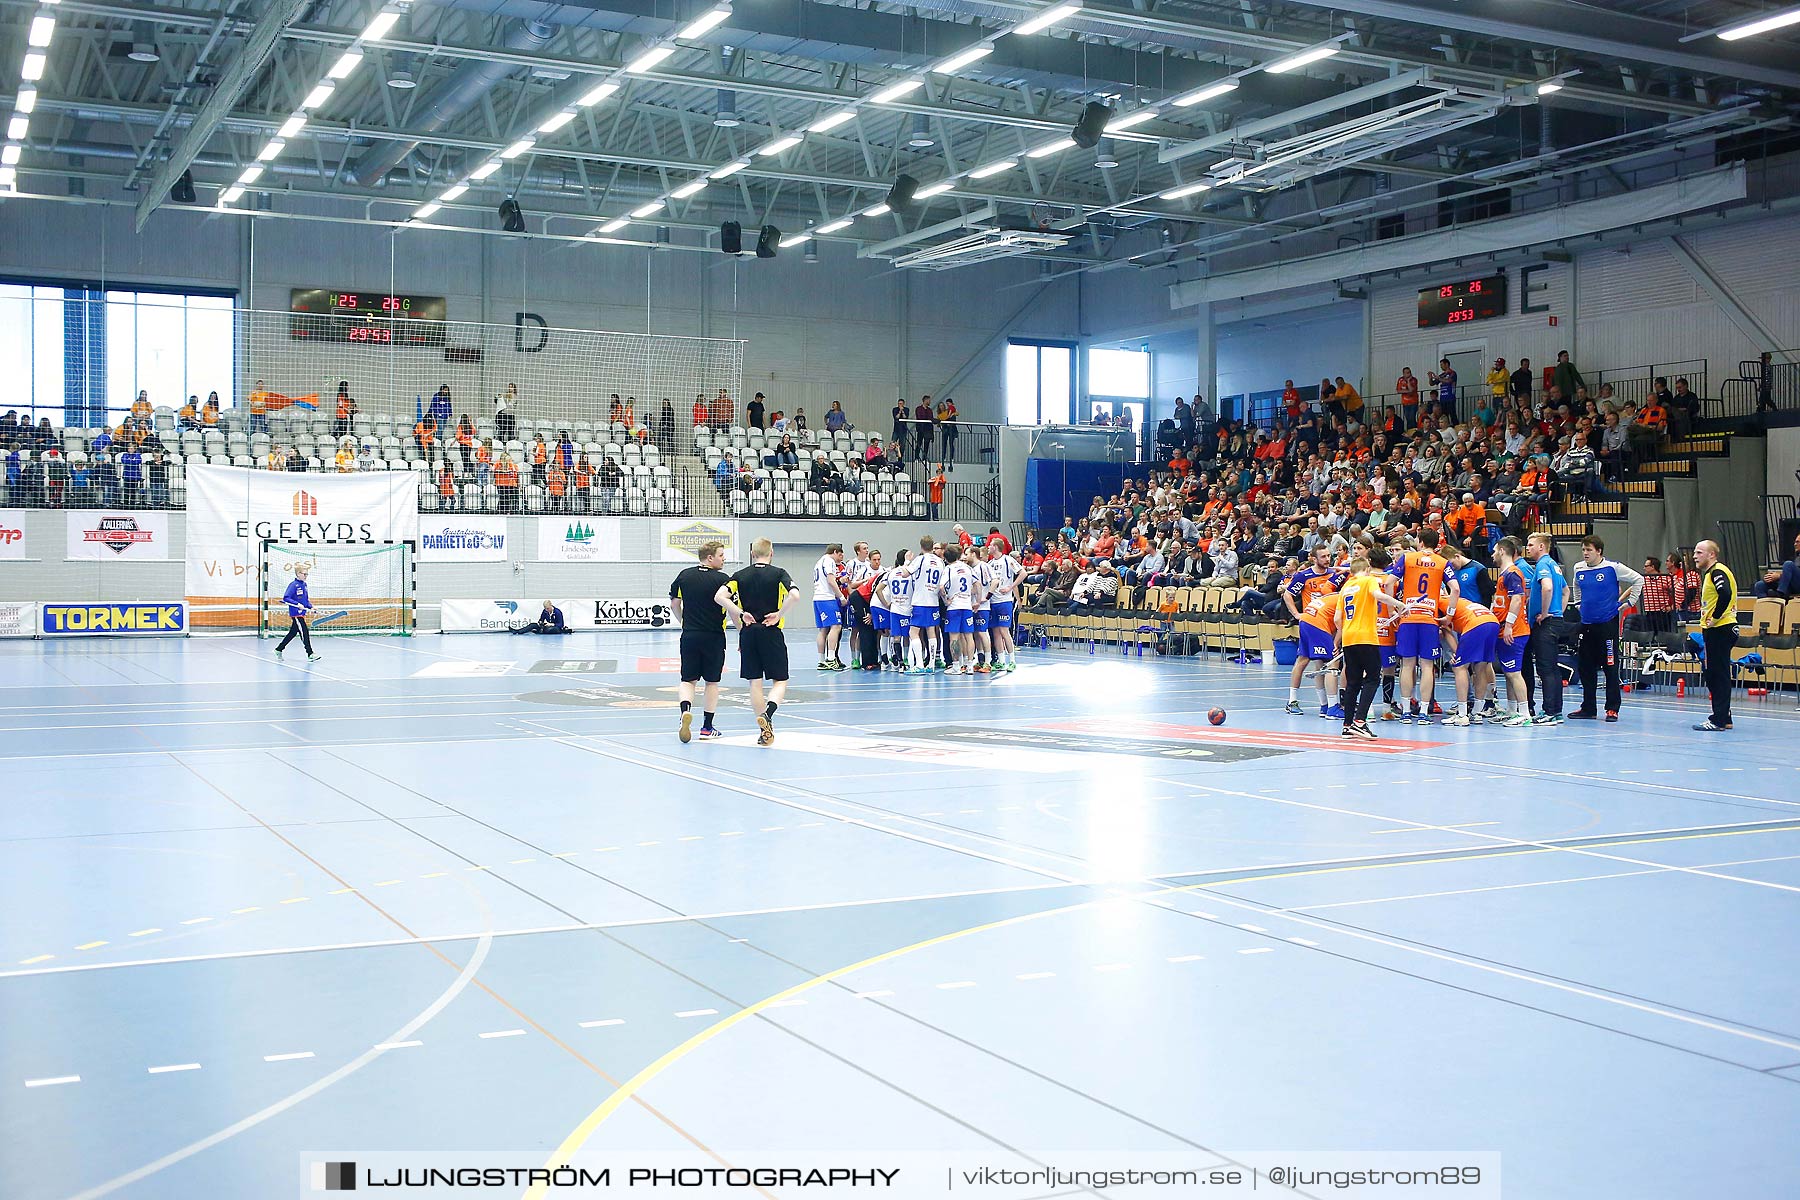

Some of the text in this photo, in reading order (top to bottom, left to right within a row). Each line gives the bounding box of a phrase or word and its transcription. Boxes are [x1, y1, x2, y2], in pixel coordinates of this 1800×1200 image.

[1440, 281, 1481, 298] 25 26
[1521, 263, 1549, 314] E
[329, 294, 411, 310] H 25 26 G
[1458, 298, 1463, 307] 2
[366, 312, 374, 323] 2
[515, 312, 549, 353] D
[236, 520, 371, 541] EGERYDS
[204, 560, 223, 577] Vi
[925, 568, 940, 585] 19
[891, 580, 909, 595] 87
[959, 577, 968, 592] 3
[1291, 582, 1304, 593] NA
[1308, 581, 1317, 589] 15
[1417, 573, 1429, 595] 6
[46, 607, 181, 630] TORMEK
[594, 600, 671, 627] Körbergs
[1313, 646, 1328, 655] NA
